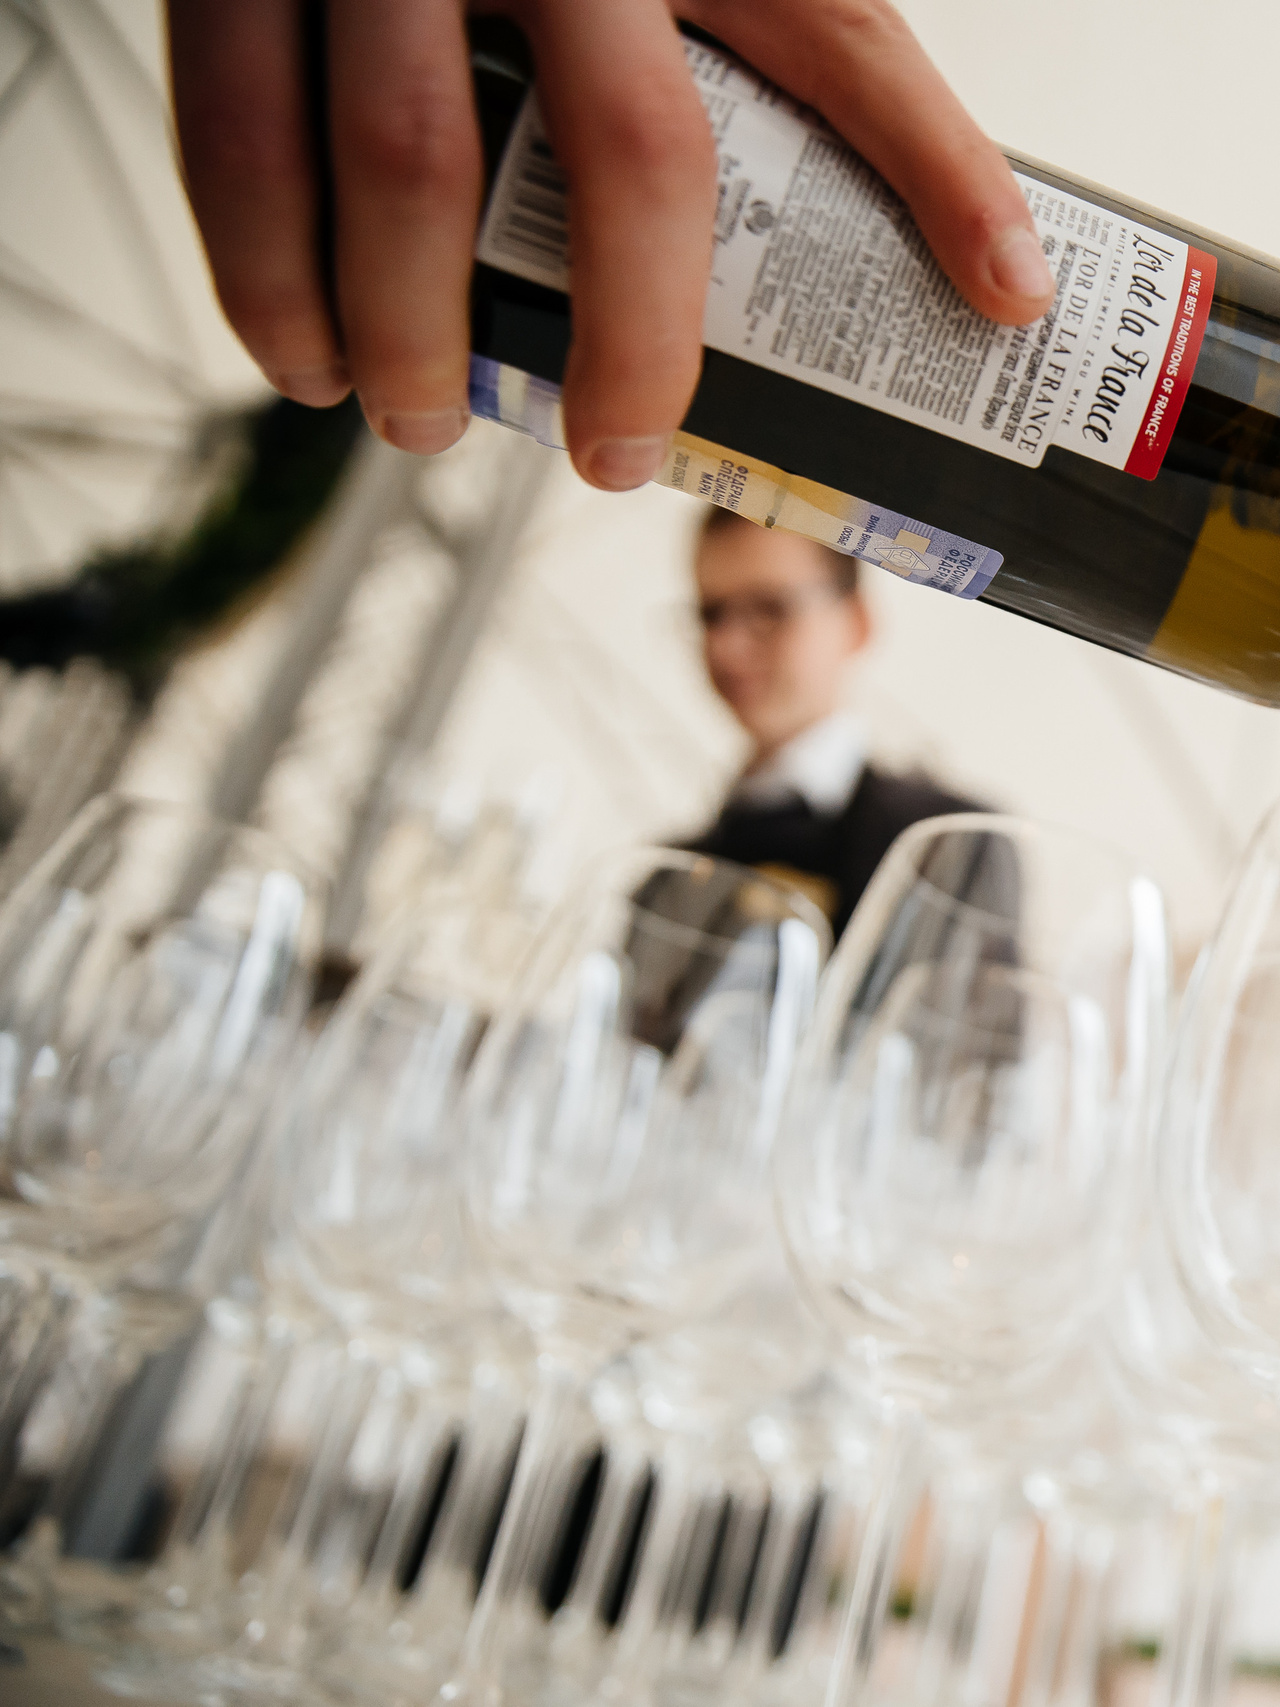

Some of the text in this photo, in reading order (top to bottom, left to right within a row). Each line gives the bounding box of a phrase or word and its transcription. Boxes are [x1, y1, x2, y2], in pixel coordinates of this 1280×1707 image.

[1116, 228, 1127, 254] WHITE
[1075, 248, 1101, 289] L'OR
[1128, 275, 1166, 307] de
[1064, 294, 1088, 324] DE
[1118, 309, 1159, 336] la
[1053, 329, 1077, 354] LA
[1145, 269, 1201, 437] IN THE BEST TRADITIONS OF FRANCE
[1062, 390, 1080, 424] WINE
[1083, 345, 1149, 443] France
[863, 515, 880, 534] ВИНА
